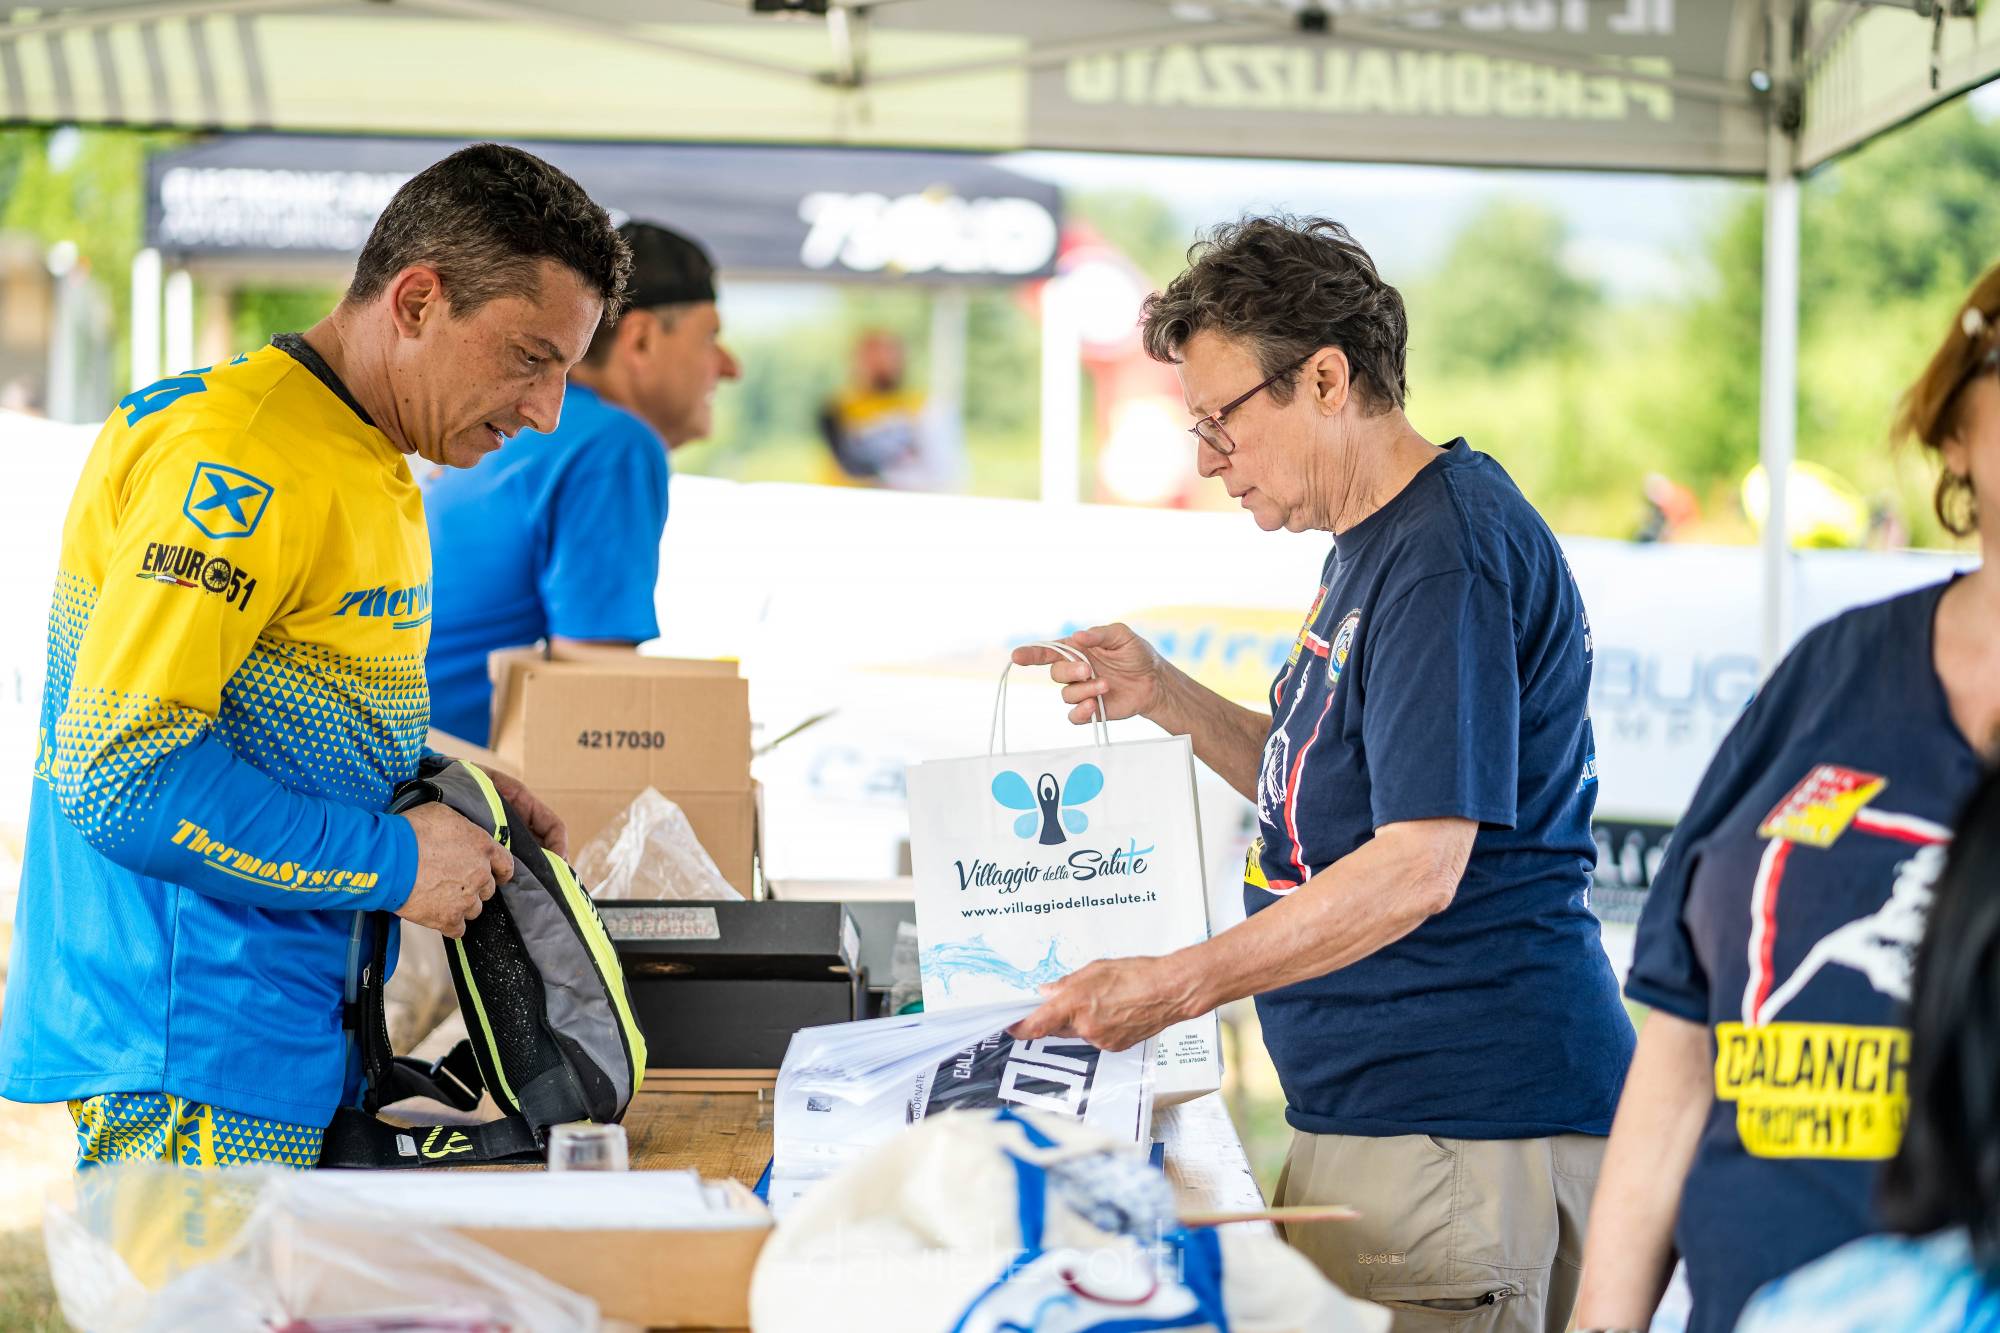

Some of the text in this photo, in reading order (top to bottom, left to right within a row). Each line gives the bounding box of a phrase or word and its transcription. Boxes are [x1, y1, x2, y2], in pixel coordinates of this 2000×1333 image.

[577, 730, 666, 749] 4217030
[171, 818, 379, 889] ThermoSystem
[954, 836, 1155, 894] Villaggio della Salute
[961, 891, 1157, 917] www.villaggiodellasalute.it
[1747, 1105, 1851, 1146] TROPHY
